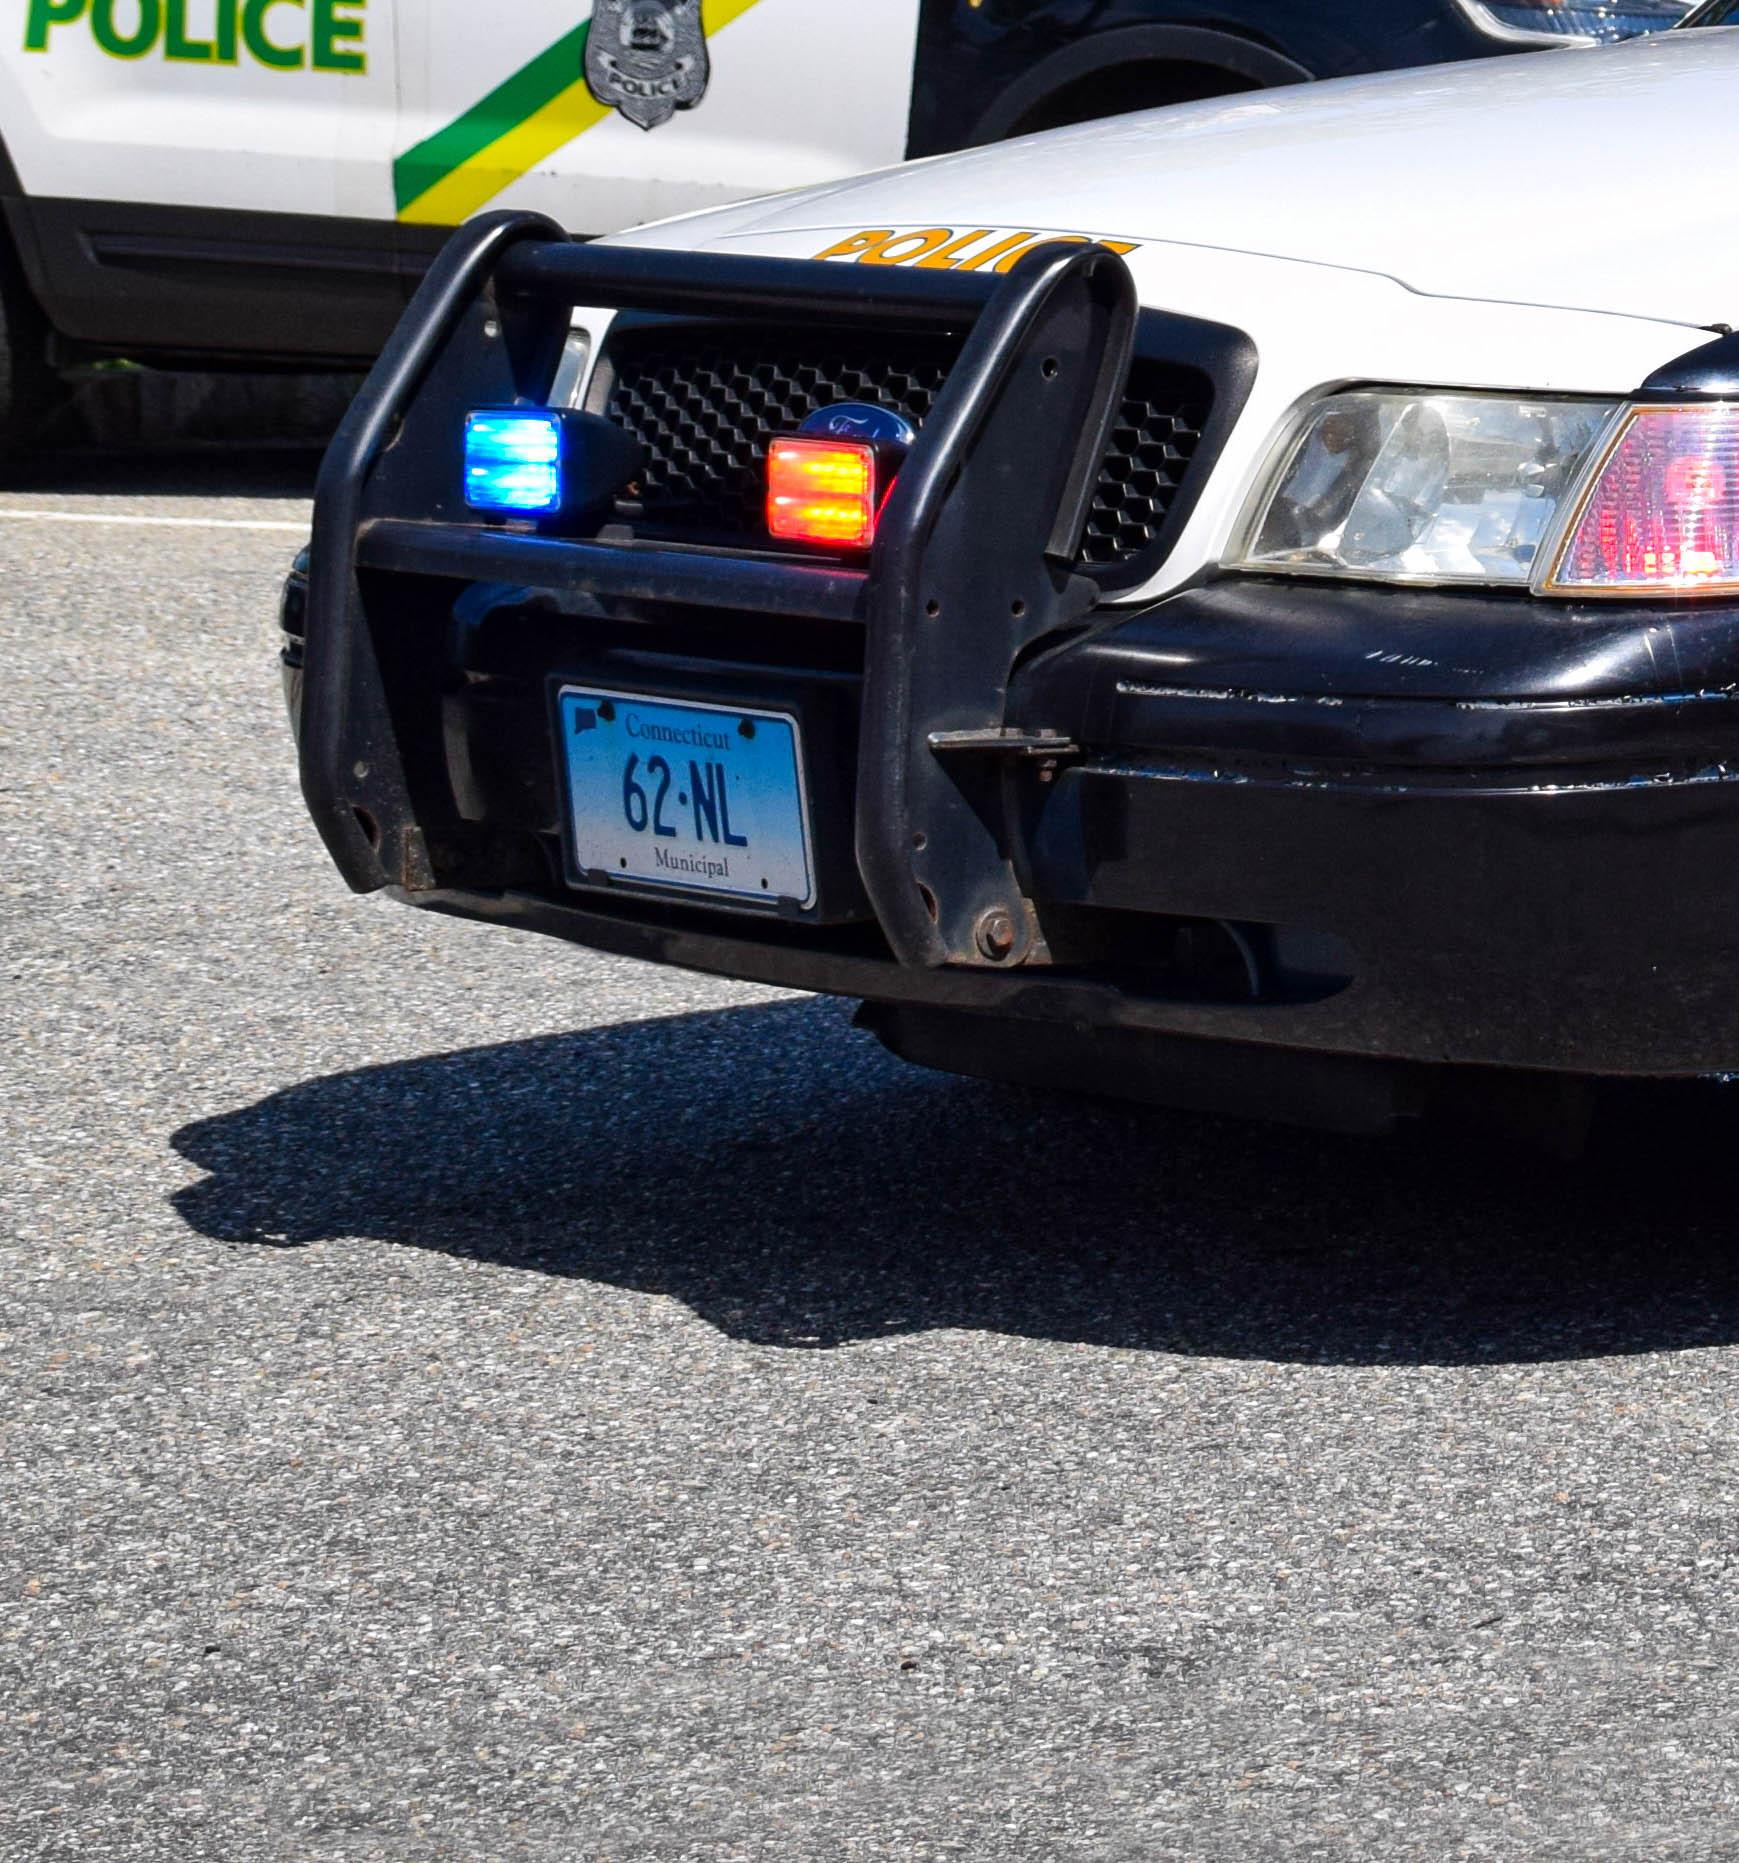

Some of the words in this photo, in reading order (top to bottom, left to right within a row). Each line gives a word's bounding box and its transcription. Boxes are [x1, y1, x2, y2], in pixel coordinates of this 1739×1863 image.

[812, 228, 1142, 273] POLIC
[625, 713, 731, 750] Connecticut
[653, 847, 730, 879] Municipal
